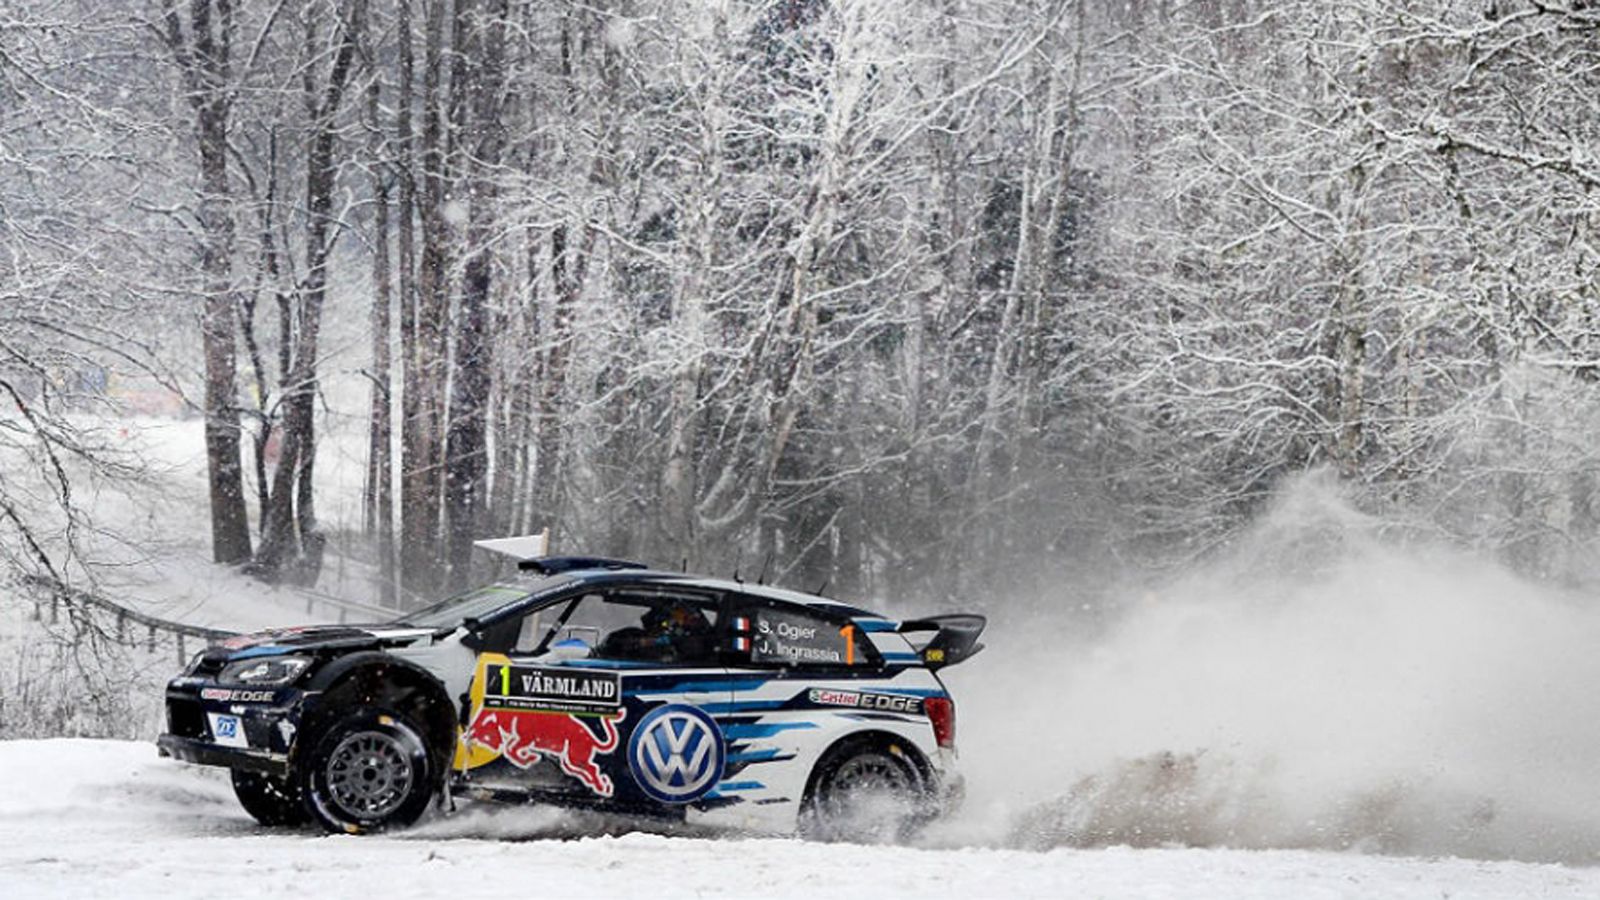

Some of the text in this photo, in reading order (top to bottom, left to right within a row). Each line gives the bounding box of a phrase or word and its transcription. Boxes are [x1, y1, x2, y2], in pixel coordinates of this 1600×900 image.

[759, 620, 816, 640] S. Ogier
[759, 641, 840, 662] J. Ingrassia
[840, 624, 855, 665] 1
[521, 671, 615, 697] VÄRMLAND
[231, 691, 274, 702] EDGE
[819, 691, 919, 712] Castrol EDGE
